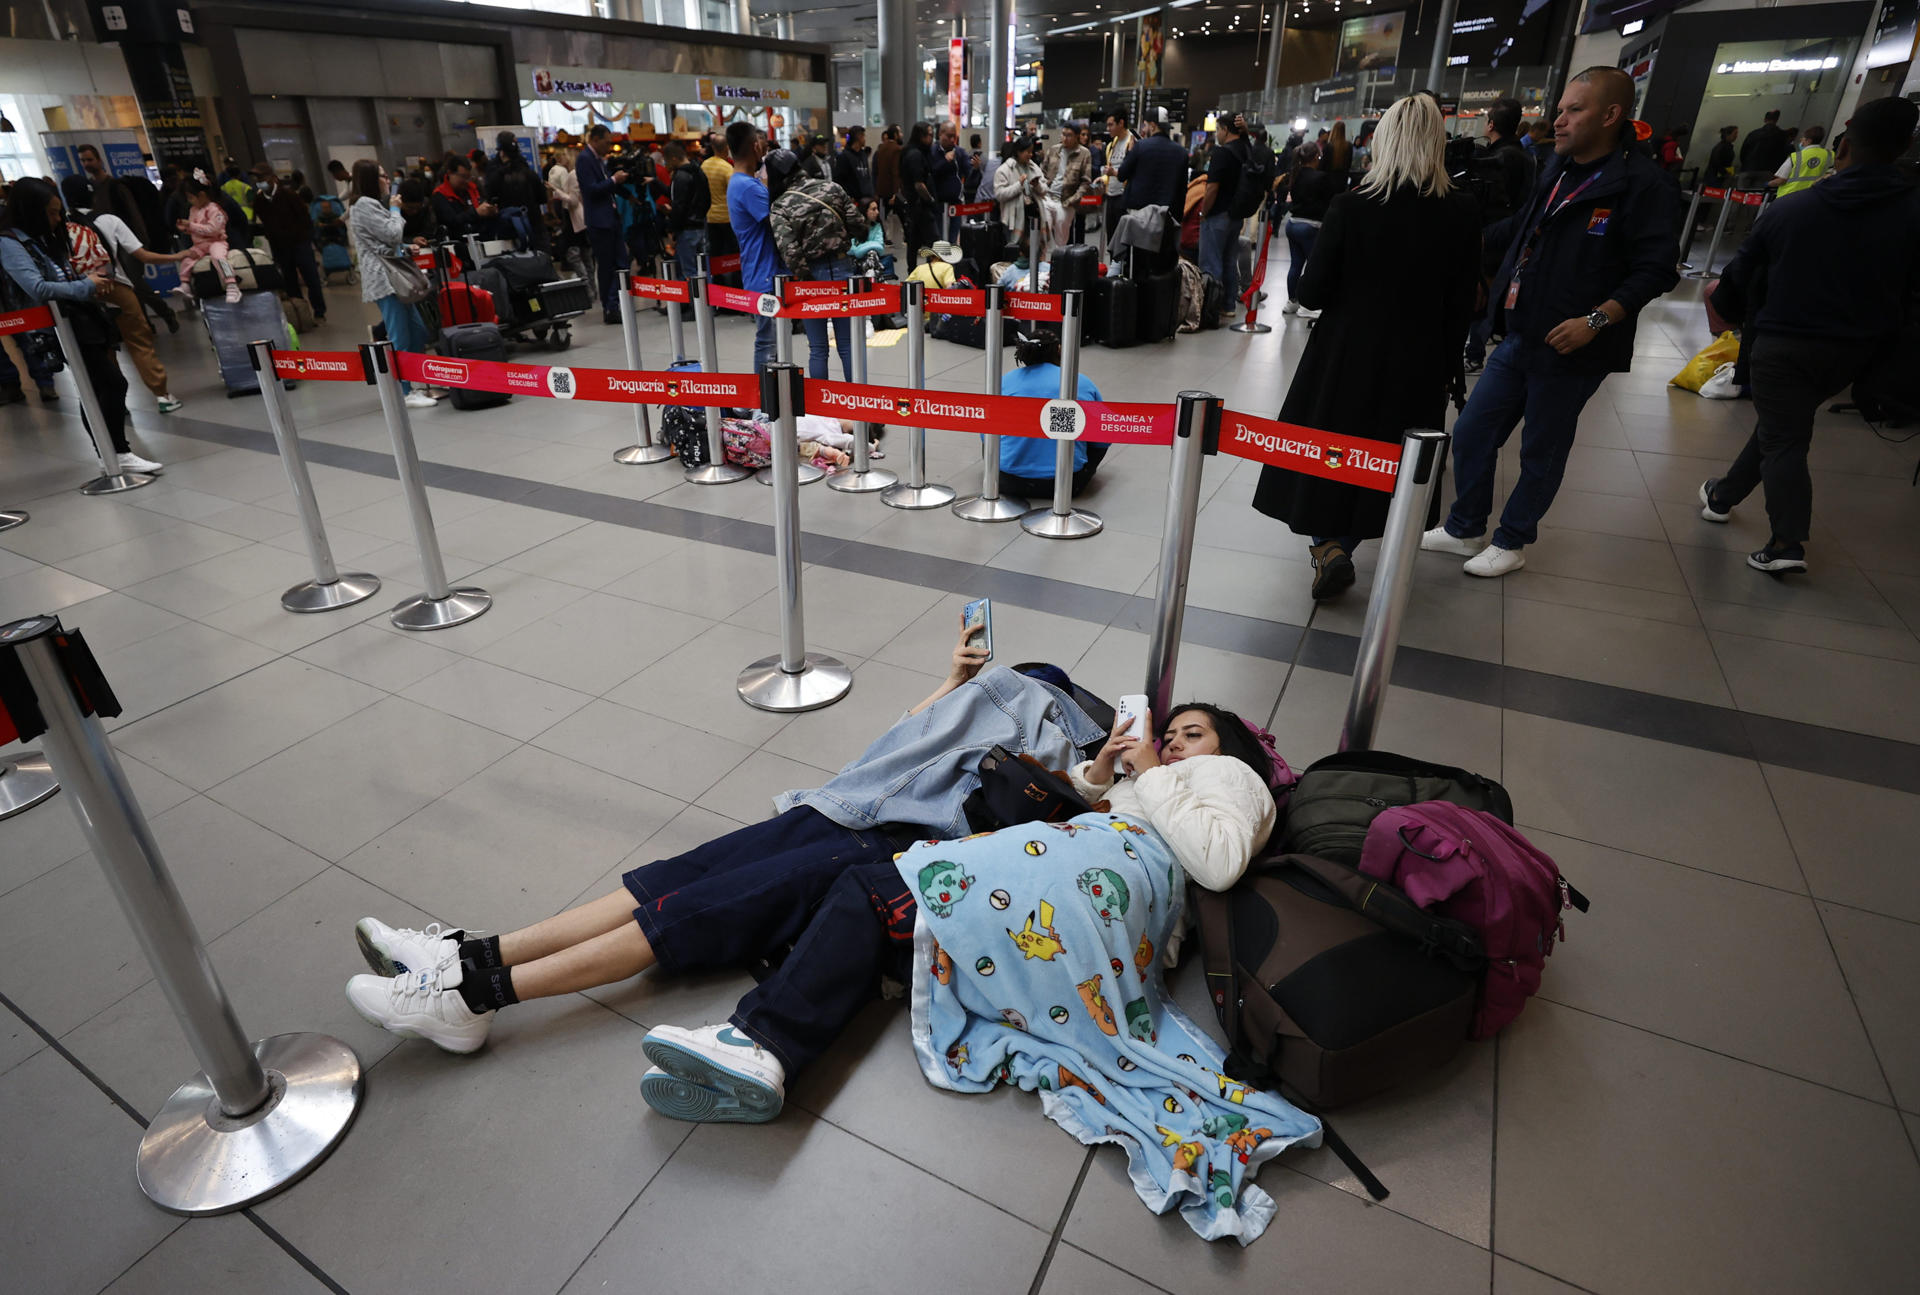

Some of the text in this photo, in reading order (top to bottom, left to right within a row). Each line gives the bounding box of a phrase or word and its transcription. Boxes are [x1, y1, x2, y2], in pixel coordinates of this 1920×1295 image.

[849, 298, 886, 309] Alemana
[930, 293, 972, 305] Alemana
[1009, 297, 1052, 311] Alemana
[306, 358, 348, 371] Alemana
[507, 371, 533, 380] ESCANEA
[508, 379, 539, 388] DESCUBRE
[607, 376, 737, 395] Droguería Alemana
[820, 388, 986, 419] Droguería Alemana
[1100, 413, 1155, 424] ESCANEA Y
[1100, 423, 1153, 434] DESCUBRE
[1234, 423, 1322, 460] Droguería
